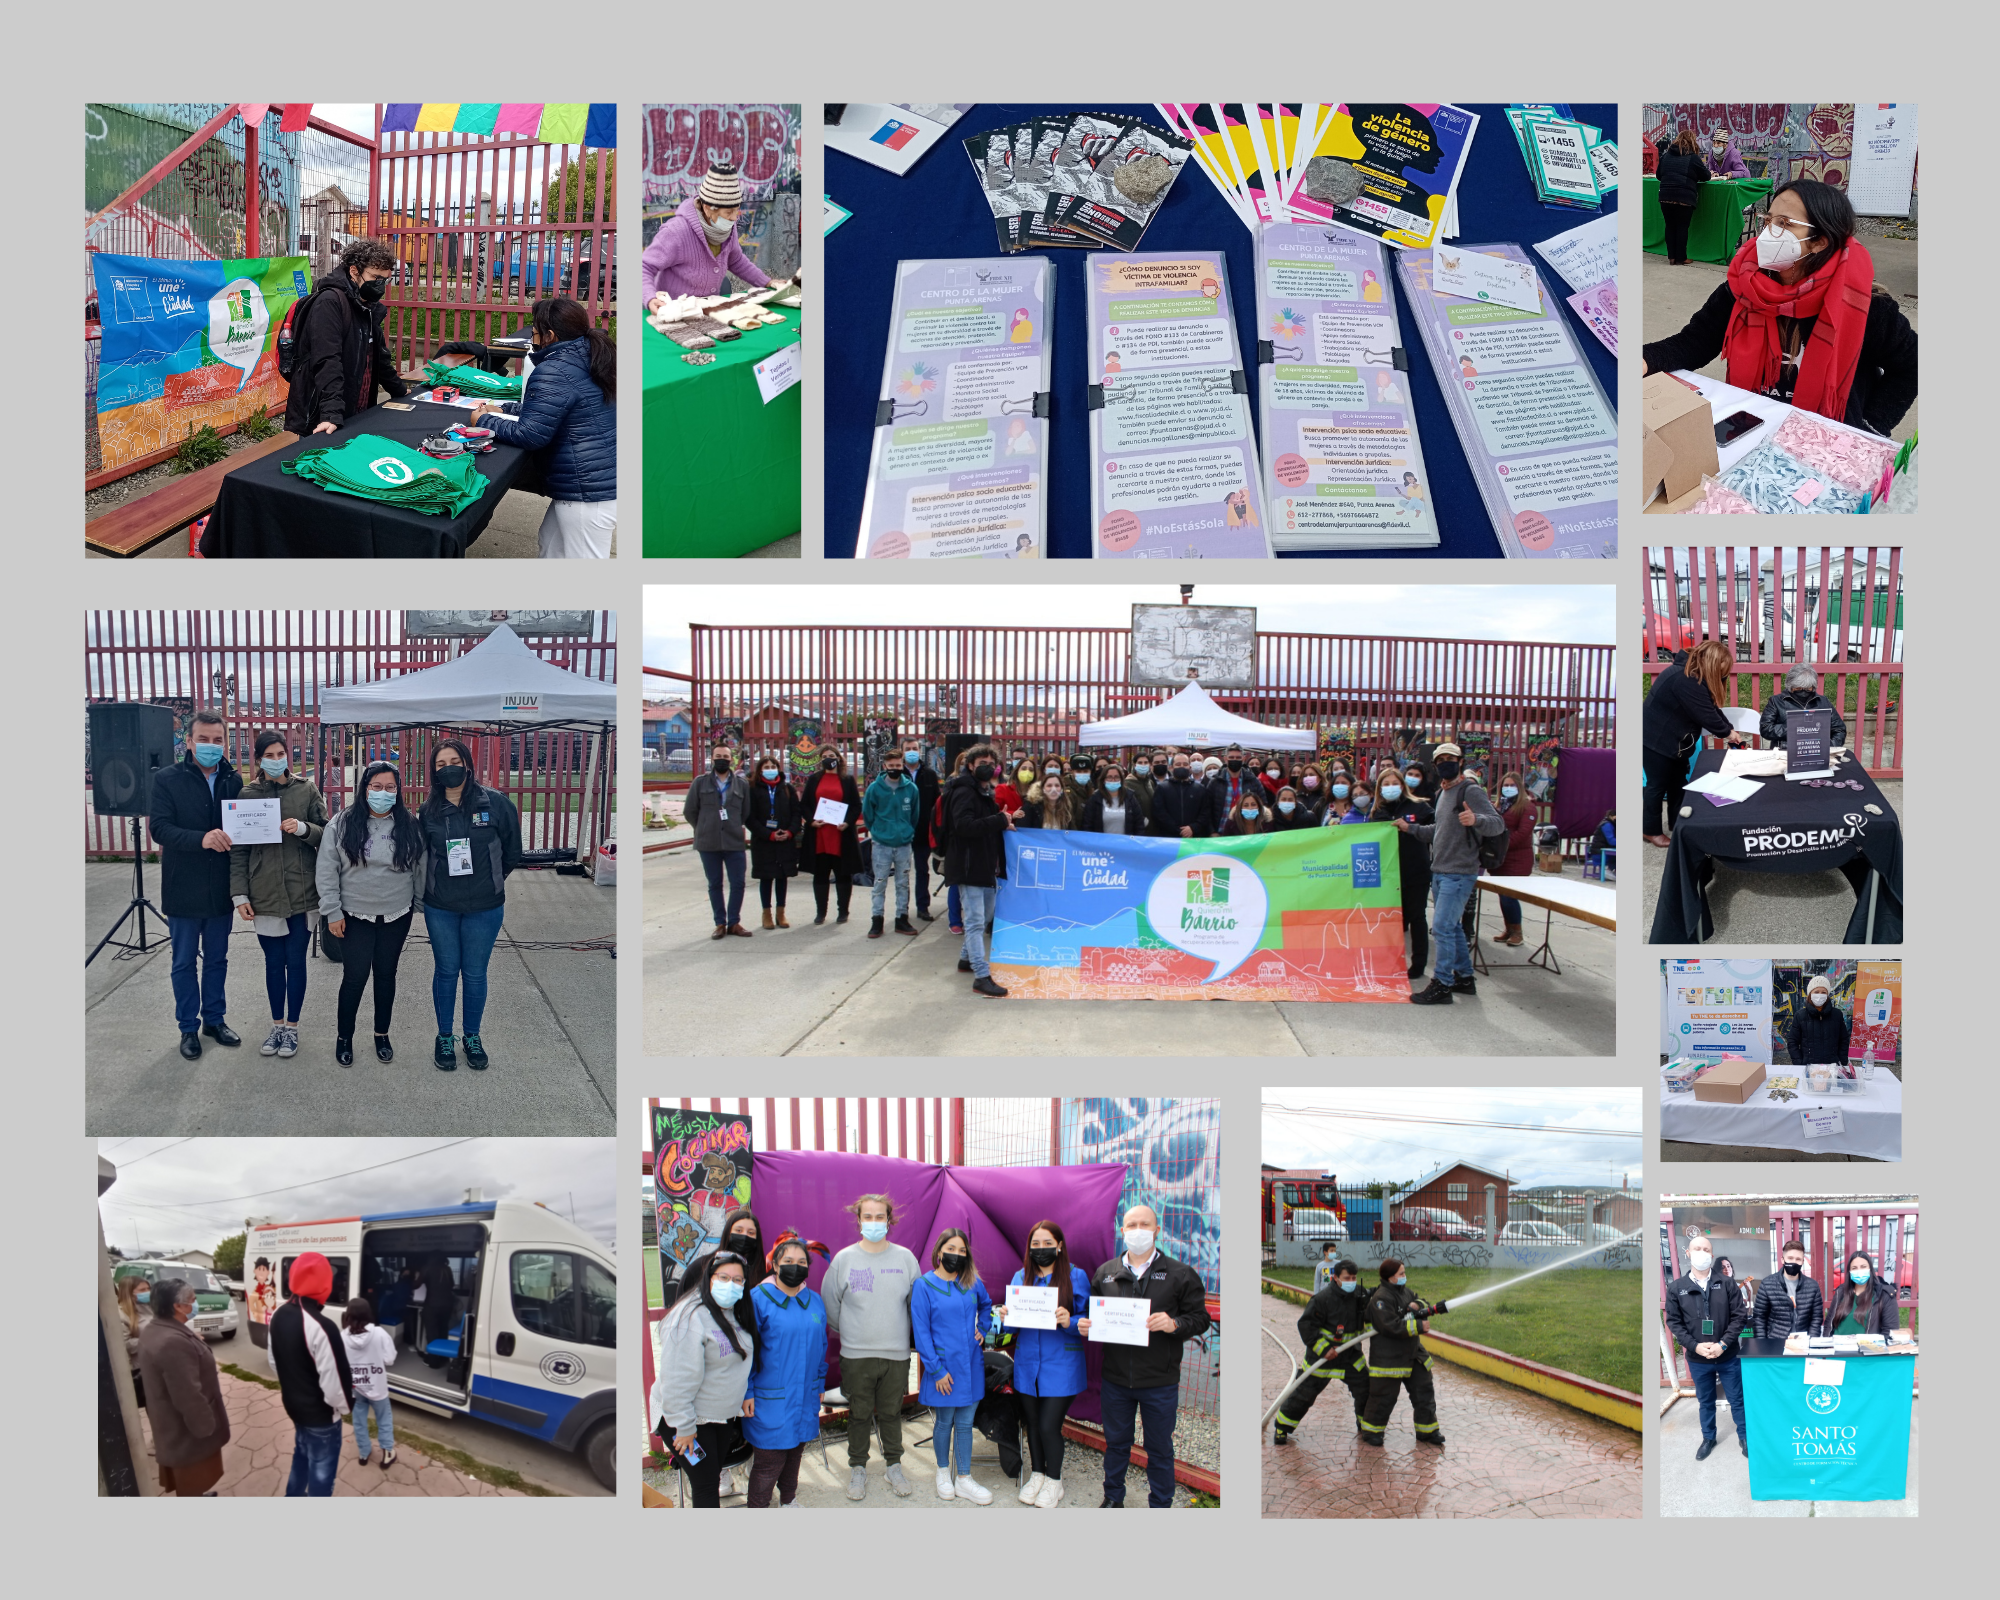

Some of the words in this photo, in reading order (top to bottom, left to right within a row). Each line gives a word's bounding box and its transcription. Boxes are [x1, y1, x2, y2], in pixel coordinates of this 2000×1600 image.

[1395, 113, 1411, 125] La
[1371, 114, 1429, 142] violencia
[1362, 121, 1379, 132] de
[1381, 129, 1430, 151] género
[1364, 134, 1389, 144] primero
[1551, 137, 1575, 147] 1455
[1364, 202, 1388, 214] 1455
[1279, 244, 1312, 252] CENTRO
[1340, 248, 1367, 256] MUJER
[1324, 254, 1350, 262] ARENAS
[1119, 265, 1143, 273] ¿CÓMO
[158, 283, 180, 293] une
[921, 289, 959, 298] CENTRO
[992, 286, 1023, 294] MUJER
[912, 490, 955, 503] Intervención
[931, 526, 975, 538] Intervención
[1146, 517, 1224, 536] #NoEstásSola
[936, 537, 974, 548] Orientación
[930, 545, 981, 558] Representación
[506, 696, 537, 705] INJUV
[1188, 732, 1208, 740] INJUV
[1742, 826, 1782, 835] Fundación
[1743, 827, 1856, 852] PRODEMU
[1746, 850, 1781, 858] Promoción
[1787, 846, 1820, 854] Desarrollo
[1082, 857, 1108, 866] une
[1302, 864, 1348, 872] Municipalidad
[1083, 869, 1129, 887] Ciudad
[1181, 907, 1238, 932] Barrio
[655, 1111, 684, 1139] ME
[671, 1114, 719, 1140] GUSTA
[656, 1120, 751, 1197] COCINAR
[371, 1366, 383, 1374] to
[353, 1376, 370, 1384] ank
[1792, 1426, 1856, 1439] SANTO
[1792, 1439, 1856, 1455] TOMÁS
